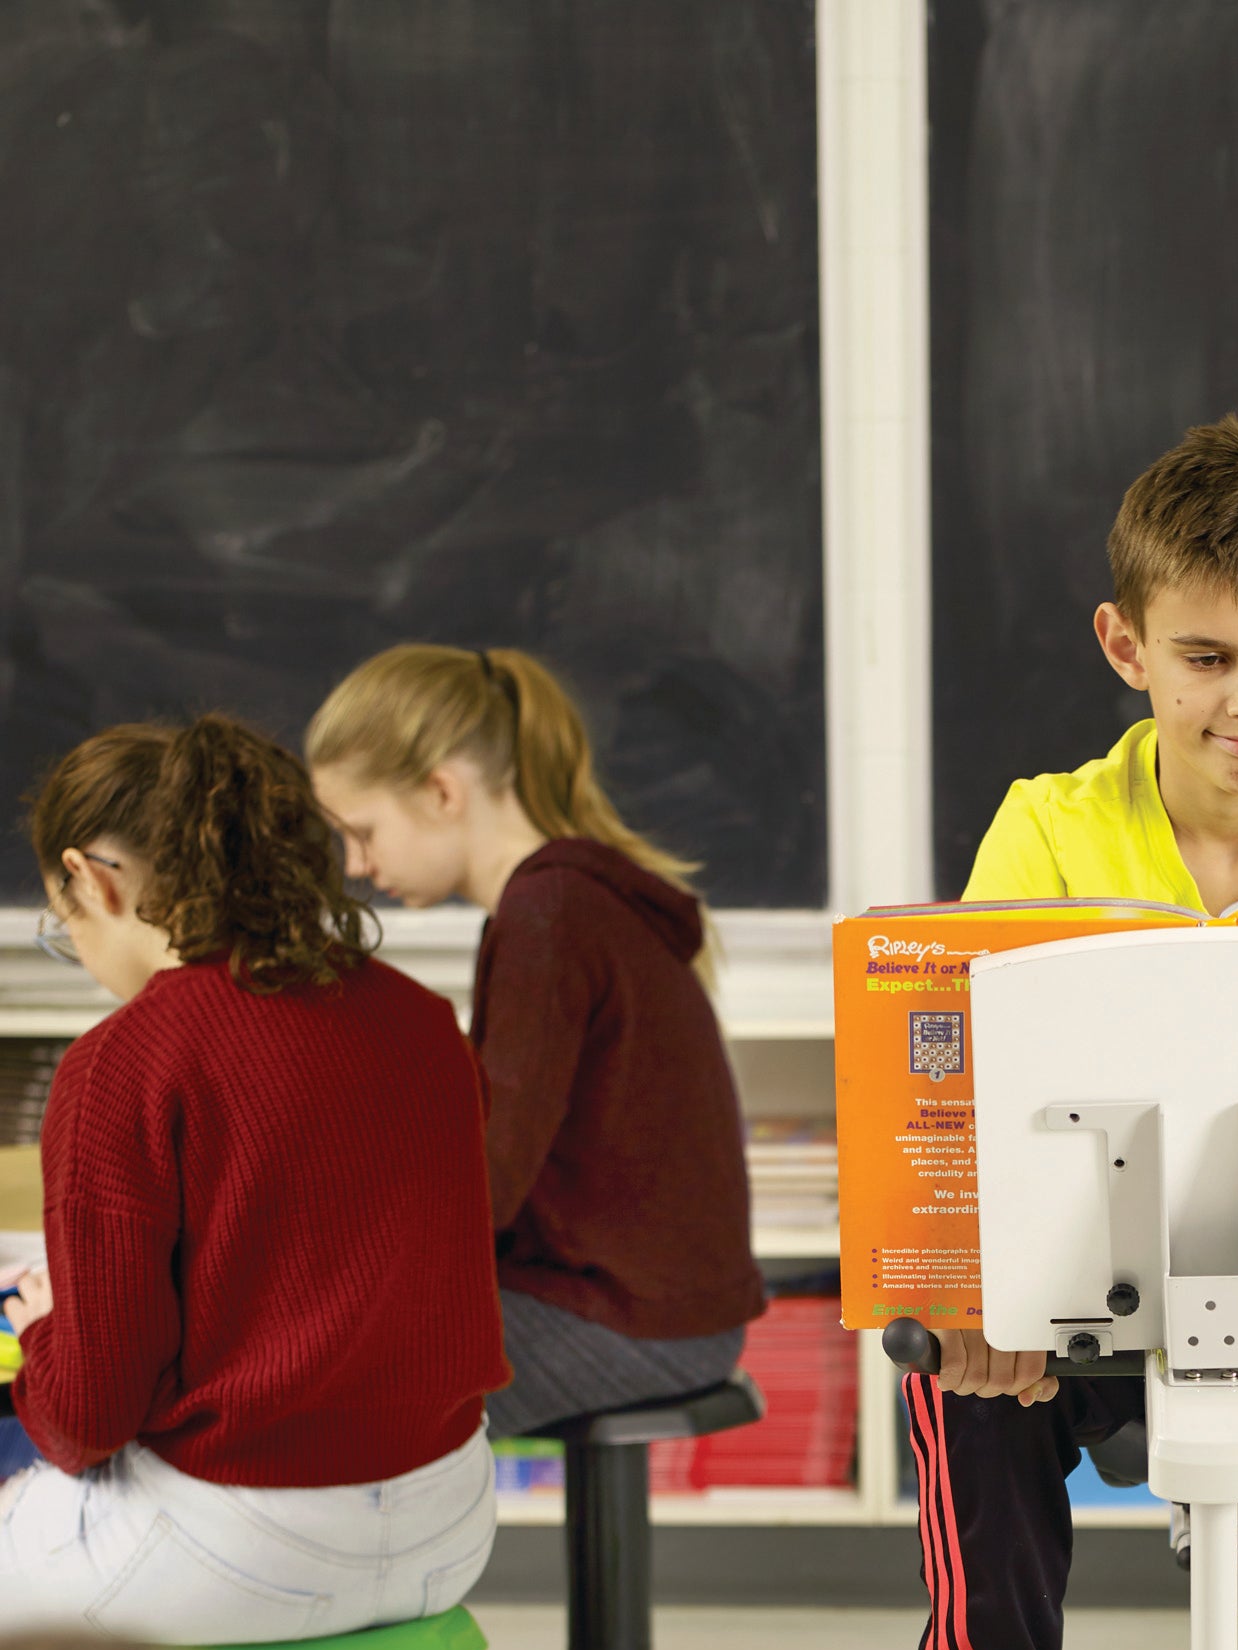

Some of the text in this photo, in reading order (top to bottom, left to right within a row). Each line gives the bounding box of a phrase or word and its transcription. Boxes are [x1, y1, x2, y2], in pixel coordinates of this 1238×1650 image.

[866, 961, 920, 975] Believe
[923, 961, 937, 975] It
[940, 964, 957, 975] or
[934, 1070, 941, 1079] 1
[915, 1098, 938, 1106] This
[920, 1109, 967, 1118] Believe
[906, 1121, 965, 1130] ALL-NEW
[895, 1134, 965, 1143] unimaginable
[903, 1146, 922, 1154] and
[925, 1146, 965, 1154] stories.
[911, 1158, 949, 1167] places,
[918, 1170, 964, 1178] credulity
[934, 1189, 955, 1199] We
[872, 1304, 923, 1316] Enter
[929, 1304, 959, 1316] the
